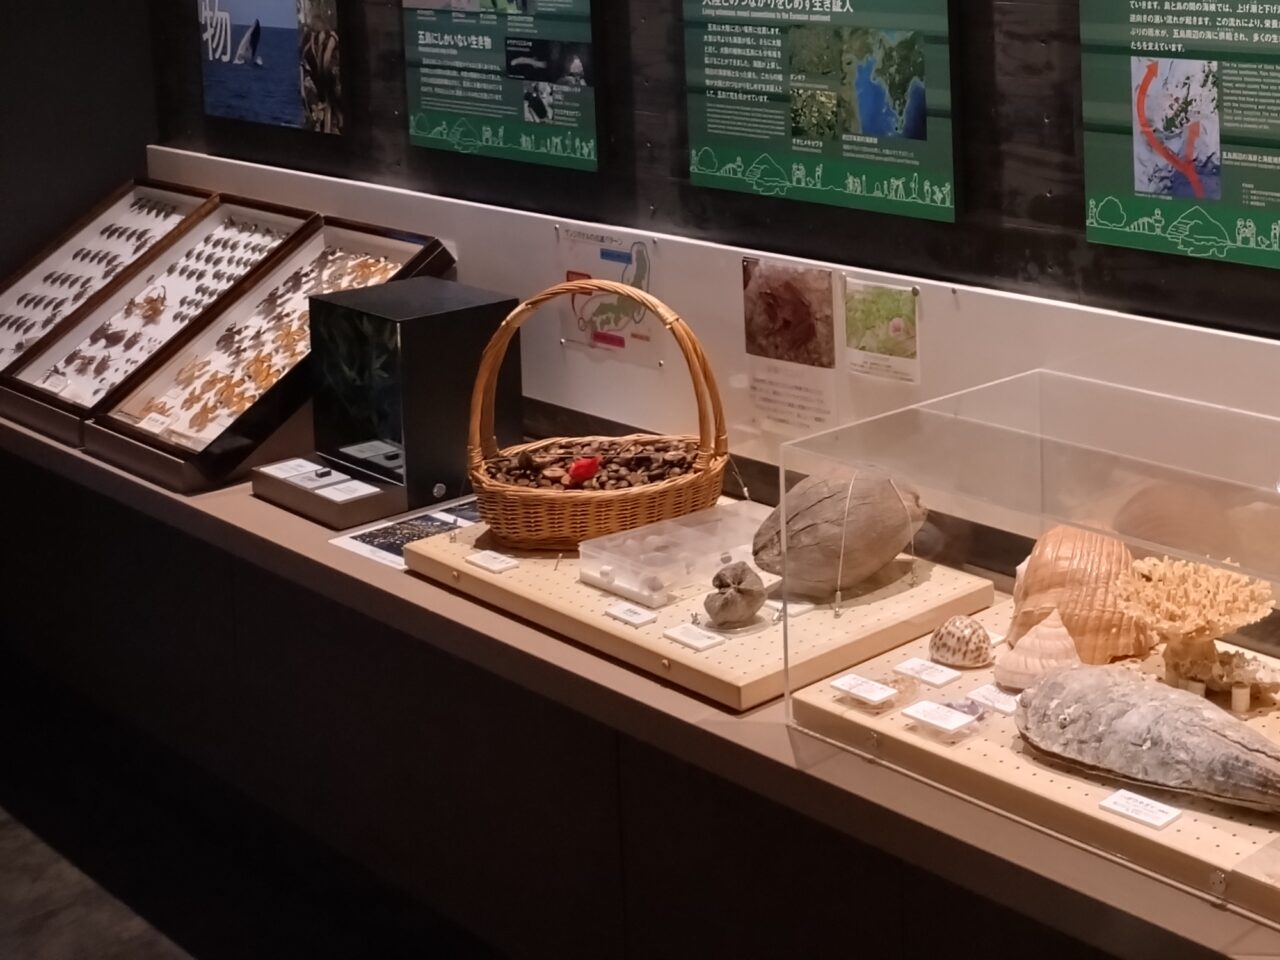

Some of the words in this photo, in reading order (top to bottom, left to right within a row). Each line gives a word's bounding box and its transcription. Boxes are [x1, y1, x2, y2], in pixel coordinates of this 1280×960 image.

[417, 30, 492, 49] 五島にしかいない生き物
